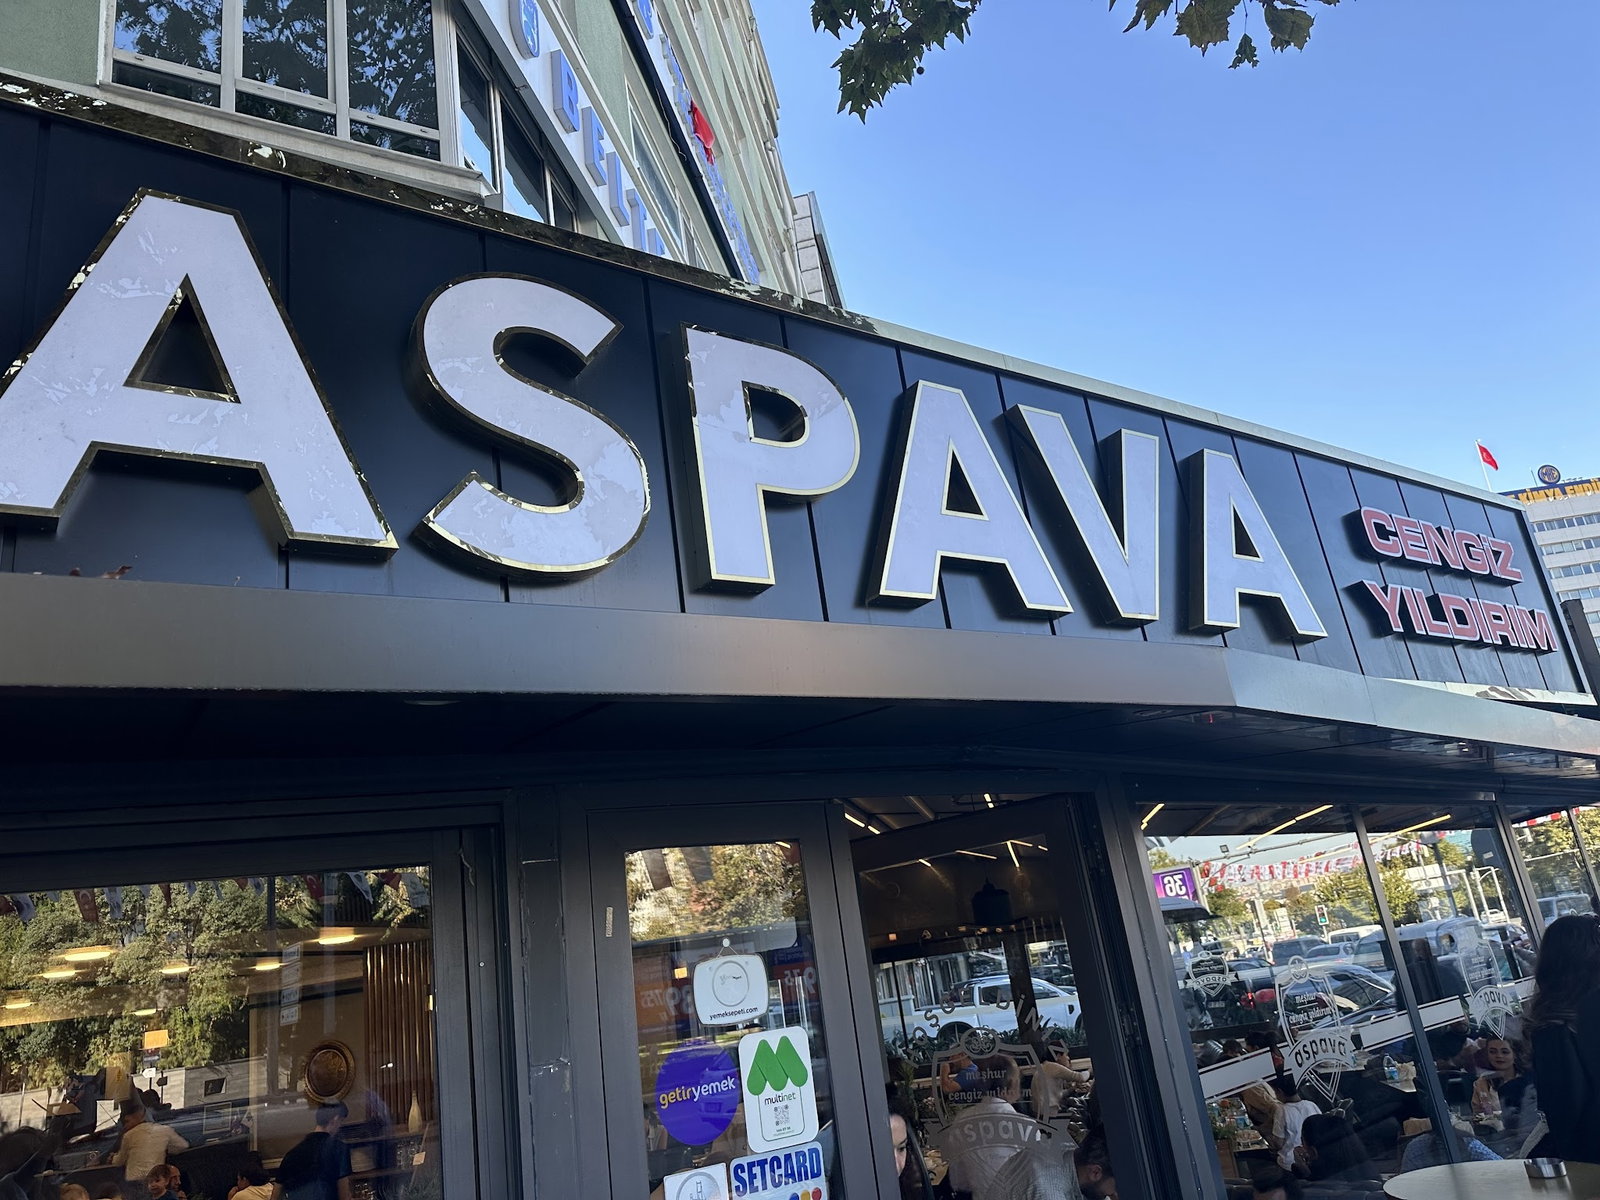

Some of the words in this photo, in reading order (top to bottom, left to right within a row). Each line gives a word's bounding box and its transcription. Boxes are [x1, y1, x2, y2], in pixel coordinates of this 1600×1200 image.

[0, 186, 1328, 637] ASPAVA
[1362, 580, 1558, 652] YILDIRIM
[709, 1006, 758, 1021] yemeksepeti.com
[1295, 1037, 1347, 1068] aspava
[659, 1076, 736, 1109] getiryemek
[764, 1092, 797, 1106] multinet
[949, 1087, 983, 1103] cengiz
[733, 1147, 822, 1197] SETCARD
